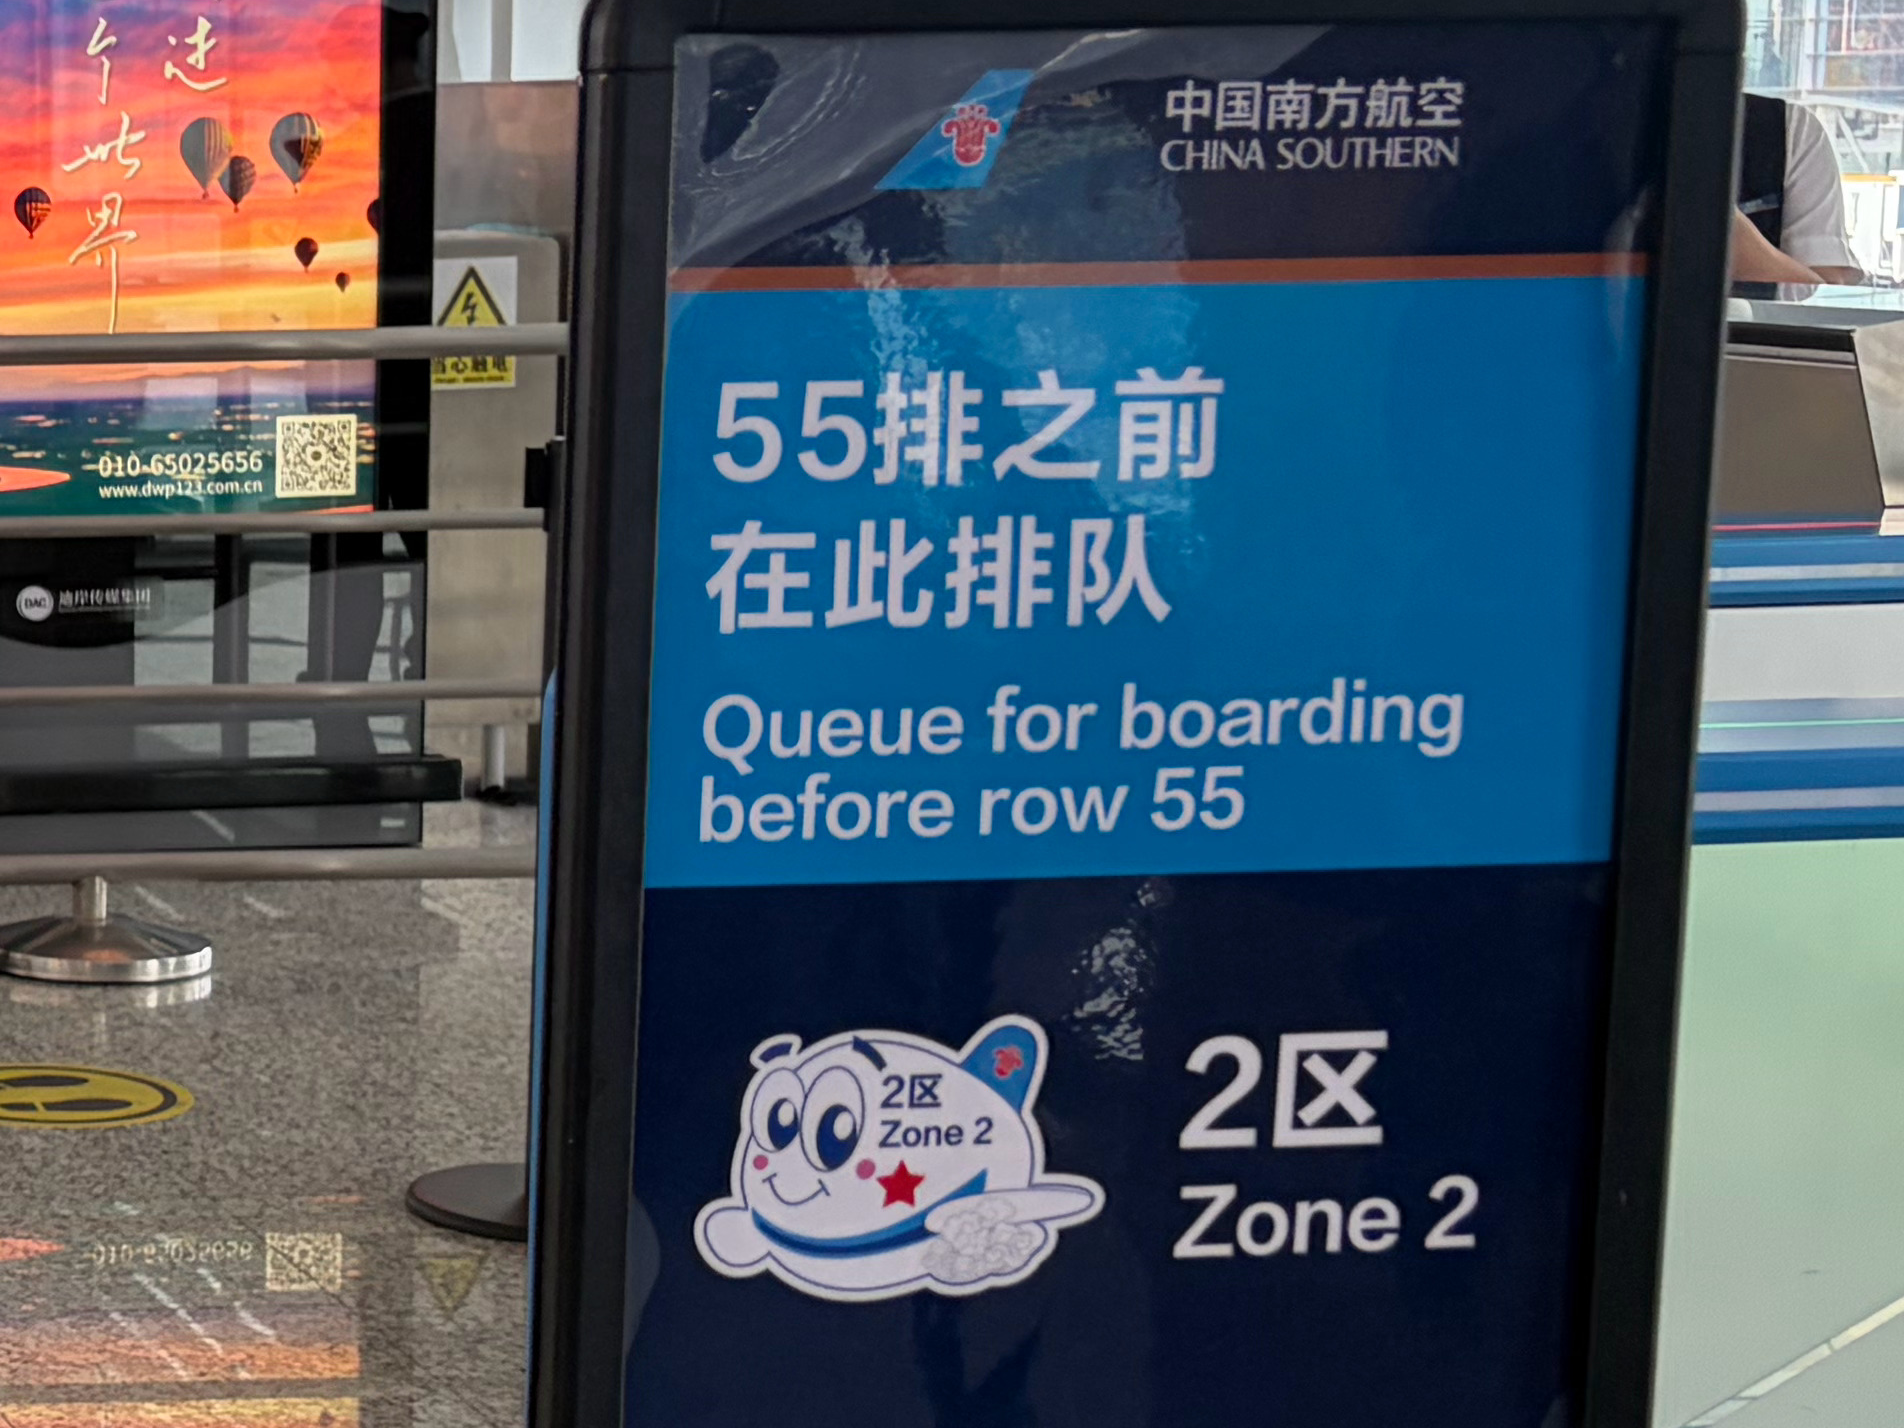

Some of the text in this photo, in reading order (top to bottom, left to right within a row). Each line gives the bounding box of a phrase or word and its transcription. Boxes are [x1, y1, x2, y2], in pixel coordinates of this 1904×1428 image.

[1165, 76, 1464, 132] 中国南方航空
[1160, 132, 1461, 173] CHINA SOUTHERN
[711, 366, 1226, 488] 55排之前
[97, 450, 264, 480] 010-65025656
[97, 479, 264, 501] www.dwp123.com.cn
[705, 515, 1173, 633] 在此排队
[700, 676, 1466, 775] Queue for boarding
[700, 766, 1246, 843] before row 55
[880, 1073, 944, 1110] 2区
[1180, 1029, 1389, 1149] 2区
[879, 1116, 994, 1149] Zone 2
[1173, 1175, 1479, 1259] Zone 2
